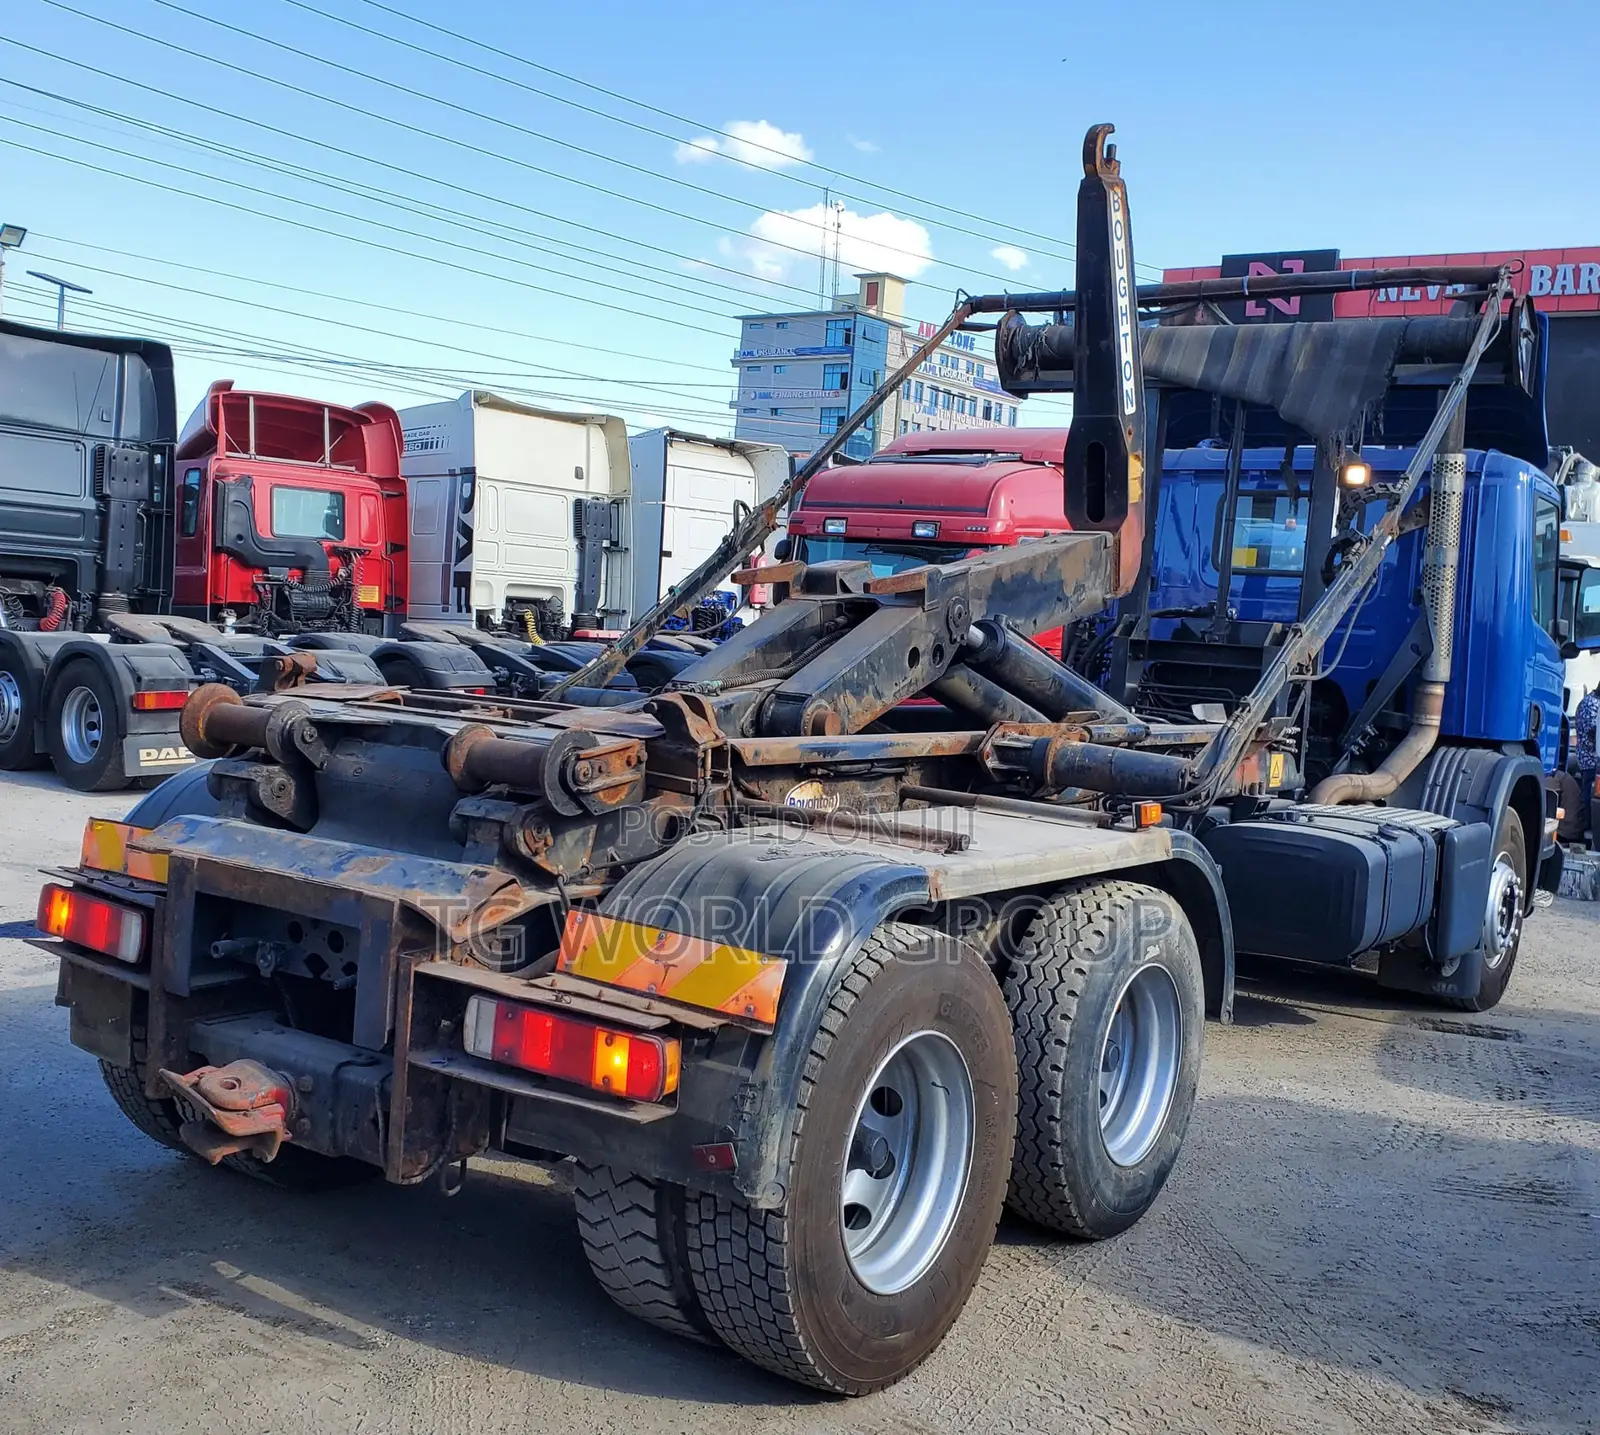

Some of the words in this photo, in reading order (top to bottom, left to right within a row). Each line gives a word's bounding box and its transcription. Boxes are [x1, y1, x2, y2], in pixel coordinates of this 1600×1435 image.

[1111, 191, 1135, 409] BOUGHTON
[756, 348, 795, 357] INSURANCE
[922, 363, 938, 376] AML
[939, 366, 973, 384] INSURANCE
[774, 391, 808, 399] FINANCE
[939, 409, 969, 424] FINANCE
